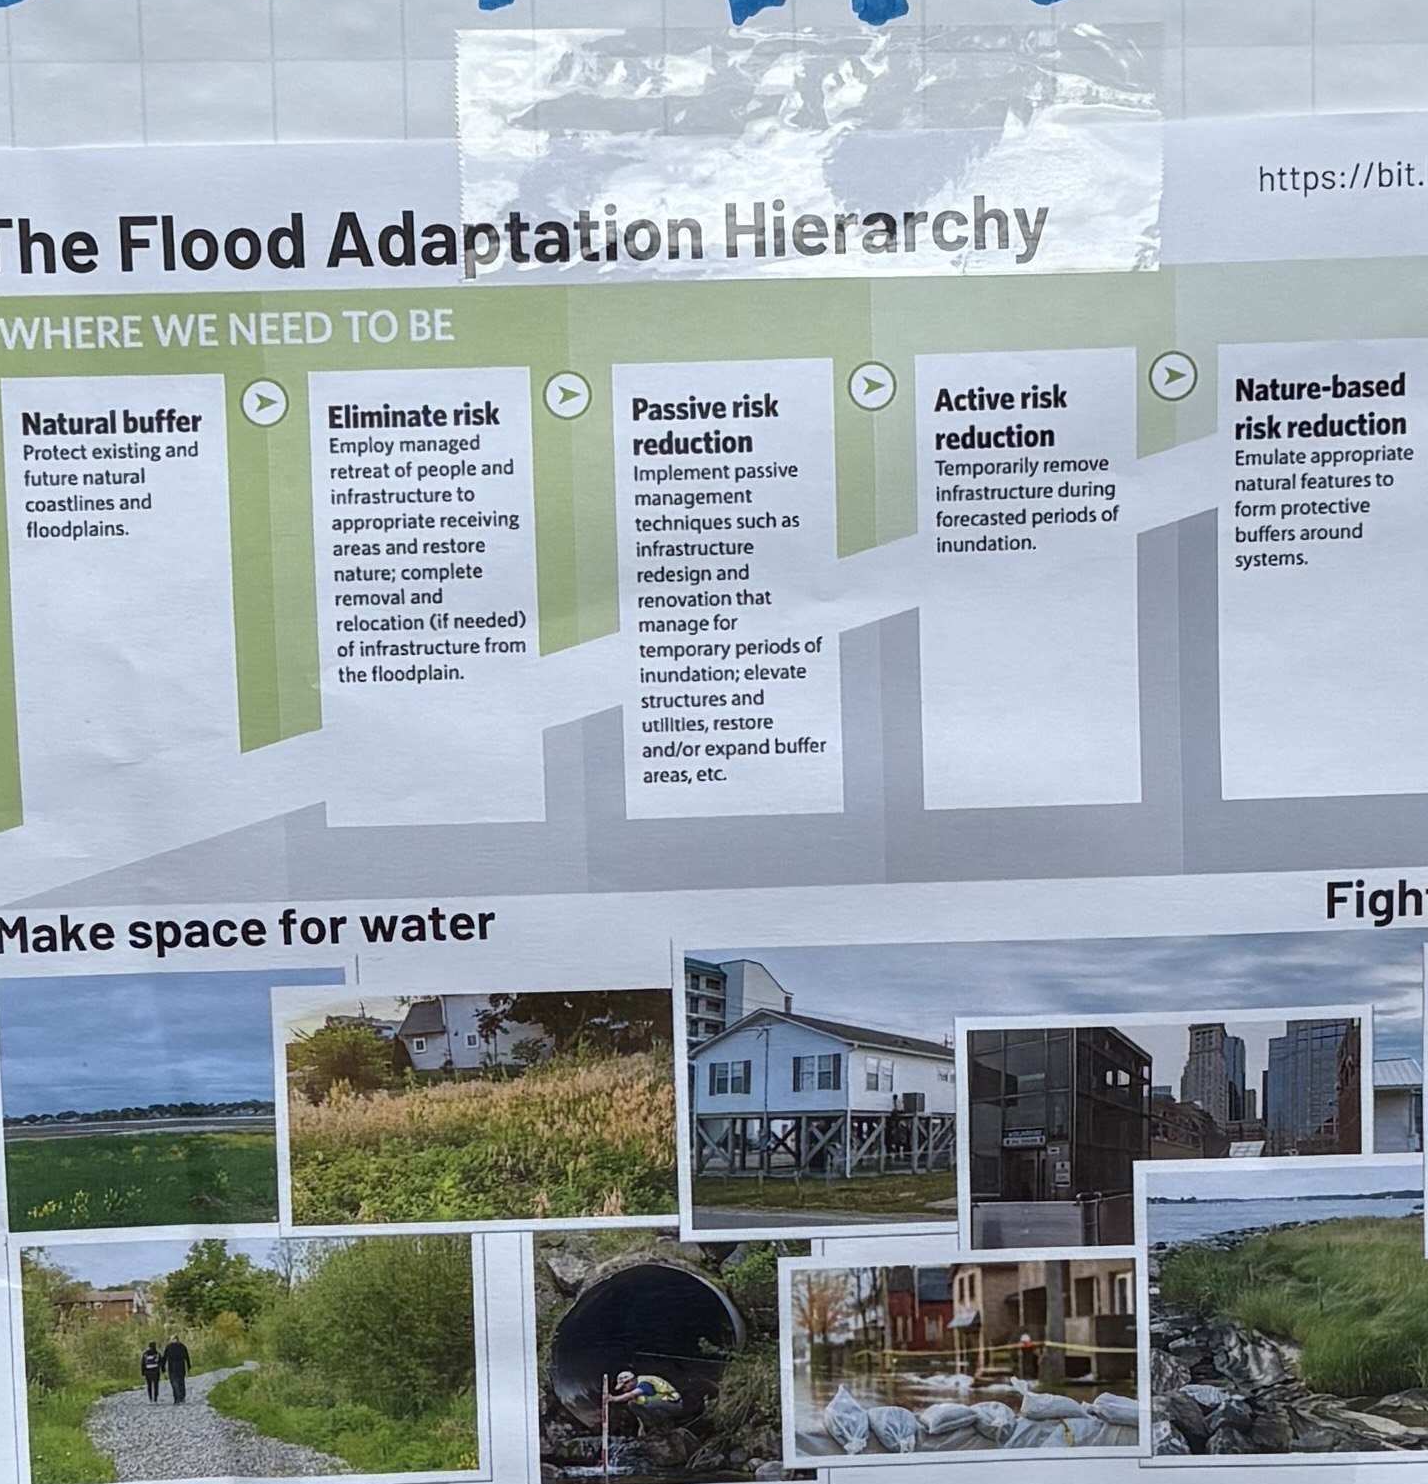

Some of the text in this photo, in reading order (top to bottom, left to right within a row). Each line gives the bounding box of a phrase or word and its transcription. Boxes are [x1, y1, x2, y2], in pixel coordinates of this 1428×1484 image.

[117, 211, 307, 274] Flood
[325, 203, 704, 280] Adaptation
[724, 195, 1050, 265] Hierarchy
[150, 312, 221, 349] WE
[227, 310, 334, 347] NEED
[340, 308, 400, 345] TO
[408, 307, 457, 343] BE
[932, 382, 1069, 414] Active risk
[1234, 370, 1407, 404] Nature-based
[327, 399, 502, 431] Eliminate risk
[631, 391, 780, 423] Passive risk
[20, 406, 204, 437] Natural buffer
[1233, 410, 1408, 442] risk reduction
[328, 432, 482, 459] Employ managed
[631, 428, 754, 457] reduction
[934, 422, 1056, 452] reduction
[22, 439, 200, 463] Protect existing and
[1234, 443, 1416, 469] Emulate appropriate
[22, 465, 147, 488] future natural
[329, 456, 515, 483] retreat of people and
[632, 460, 800, 487] Implement passive
[932, 455, 1111, 481] Temporarily remove
[935, 479, 1117, 503] infrastructure during
[1234, 471, 1396, 493] natural features to
[24, 491, 153, 514] coastlines and
[329, 485, 477, 506] infrastructure to
[633, 488, 754, 511] management
[934, 503, 1121, 530] forecasted periods of
[1233, 496, 1372, 521] form protective
[25, 518, 131, 543] floodplains.
[330, 509, 521, 535] appropriate receiving
[633, 510, 801, 536] techniques such as
[1234, 521, 1364, 544] buffers around
[331, 536, 487, 558] areas and restore
[635, 538, 756, 559] infrastructure
[935, 533, 1038, 555] inundation.
[332, 561, 484, 585] nature; complete
[635, 562, 751, 587] redesign and
[1233, 551, 1310, 573] systems.
[333, 586, 444, 608] removal and
[636, 587, 773, 610] renovation that
[335, 609, 528, 634] relocation (if needed)
[637, 612, 739, 637] manage for
[335, 635, 528, 659] of infrastructure from
[637, 634, 824, 663] temporary periods of
[337, 662, 466, 686] the floodplain.
[639, 662, 808, 685] inundation; elevate
[640, 687, 766, 710] structures and
[640, 715, 775, 735] utilities, restore
[641, 735, 828, 762] and/or expand buffer
[642, 766, 729, 786] areas, etc.
[127, 917, 268, 960] space
[277, 907, 349, 947] for
[357, 905, 497, 944] water
